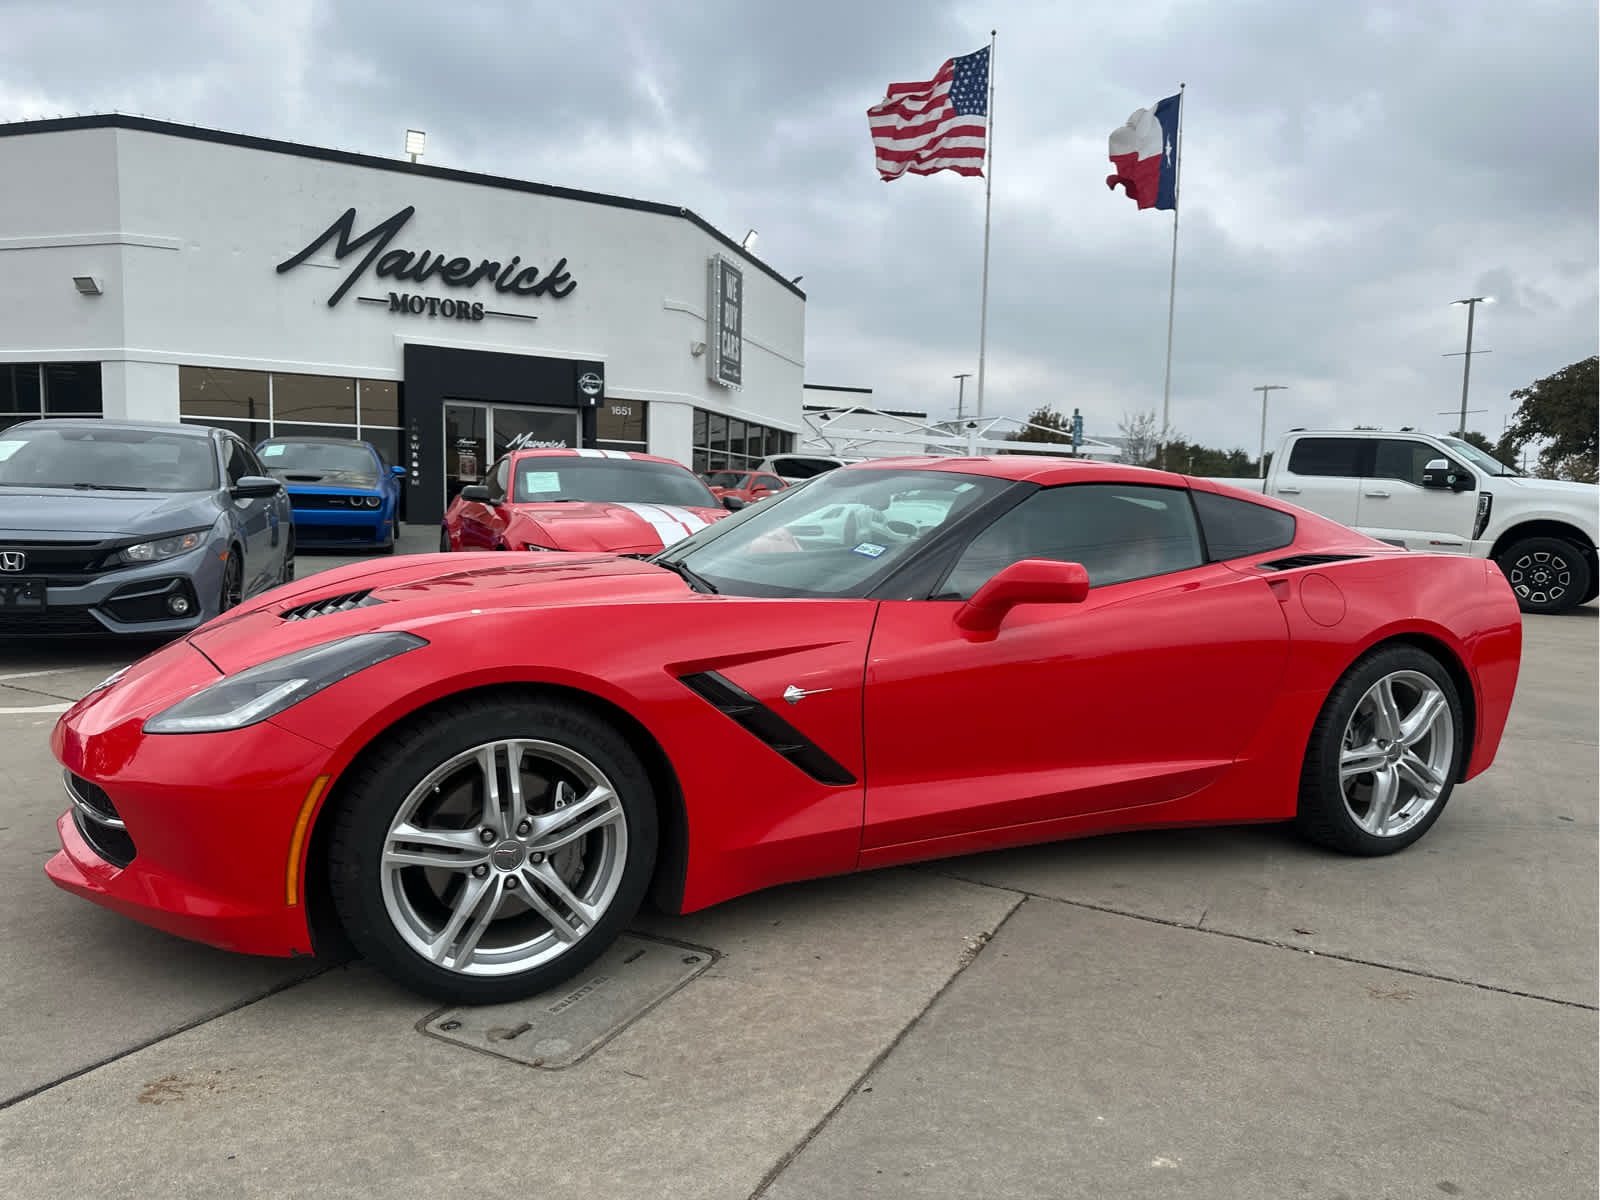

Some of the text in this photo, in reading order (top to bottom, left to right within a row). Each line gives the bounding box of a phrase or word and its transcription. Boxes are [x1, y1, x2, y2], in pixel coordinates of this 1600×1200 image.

[276, 205, 577, 307] Maverick
[725, 271, 738, 302] WE
[388, 292, 484, 321] MOTORS
[724, 301, 738, 332] BUY
[722, 330, 739, 362] CARS
[611, 406, 632, 416] 1651
